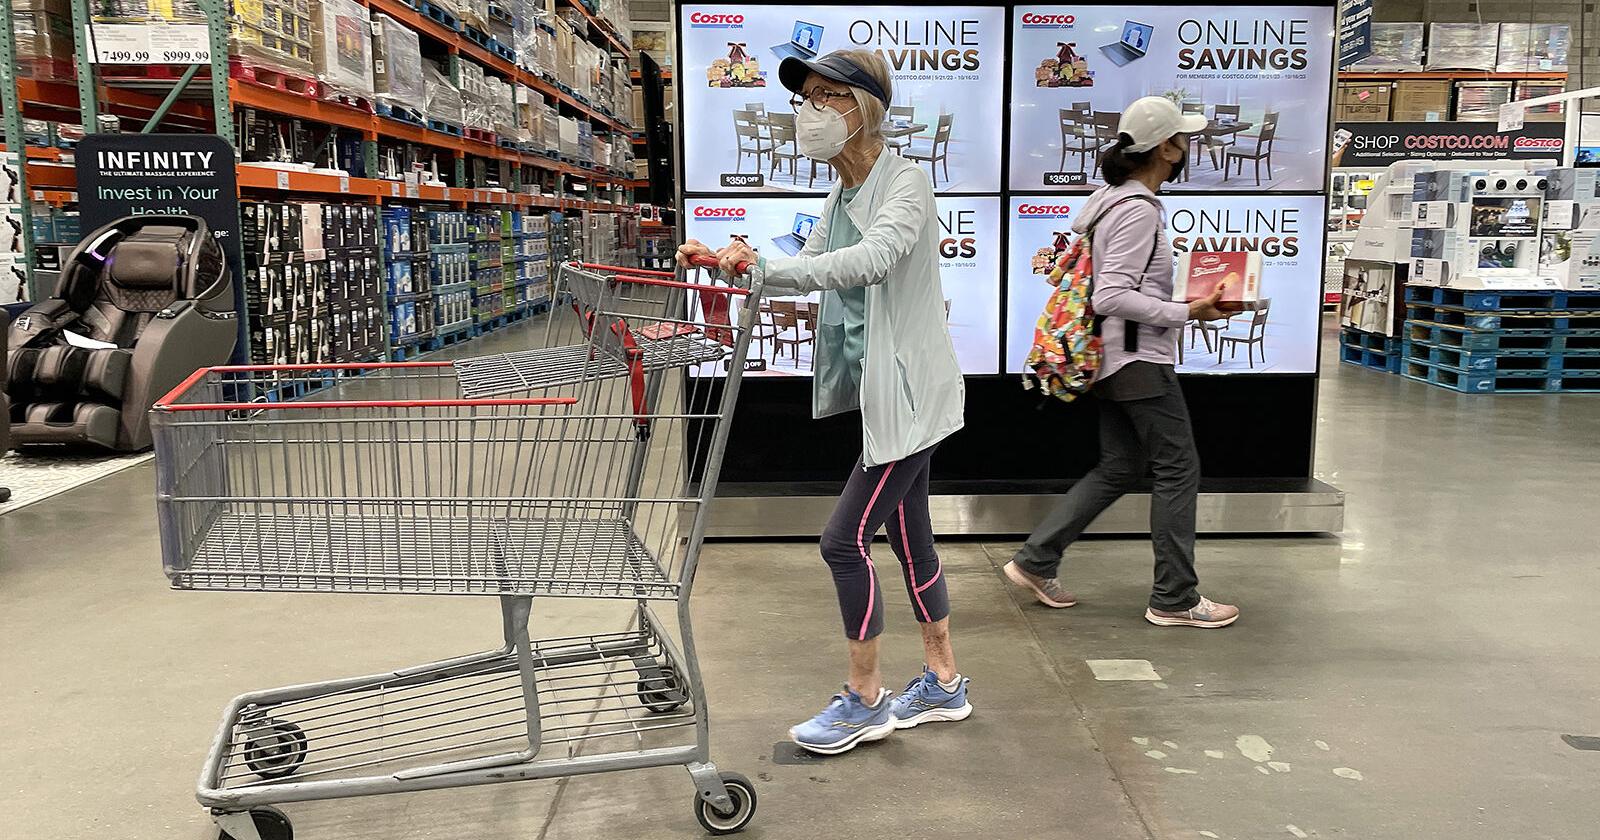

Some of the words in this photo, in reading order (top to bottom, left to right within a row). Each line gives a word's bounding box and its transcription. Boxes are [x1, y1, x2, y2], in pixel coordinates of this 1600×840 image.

[690, 12, 745, 24] COSTCO
[1022, 12, 1076, 24] COSTCO
[849, 20, 979, 46] ONLINE
[1177, 20, 1308, 46] ONLINE
[102, 51, 150, 61] 7499.99
[873, 49, 980, 71] VINGS
[1177, 48, 1308, 70] SAVINGS
[1354, 135, 1399, 149] SHOP
[1404, 135, 1509, 149] COSTCO.COM
[1514, 137, 1563, 147] COSTCO
[97, 151, 213, 169] INFINITY
[726, 176, 747, 185] $350
[1050, 175, 1070, 183] $350
[98, 186, 152, 200] Invest
[157, 186, 173, 200] in
[177, 186, 219, 200] Your
[694, 206, 746, 217] COSTCO
[1018, 203, 1071, 214] COSTCO
[1171, 209, 1299, 233] ONLINE
[1172, 236, 1299, 257] SAVINGS
